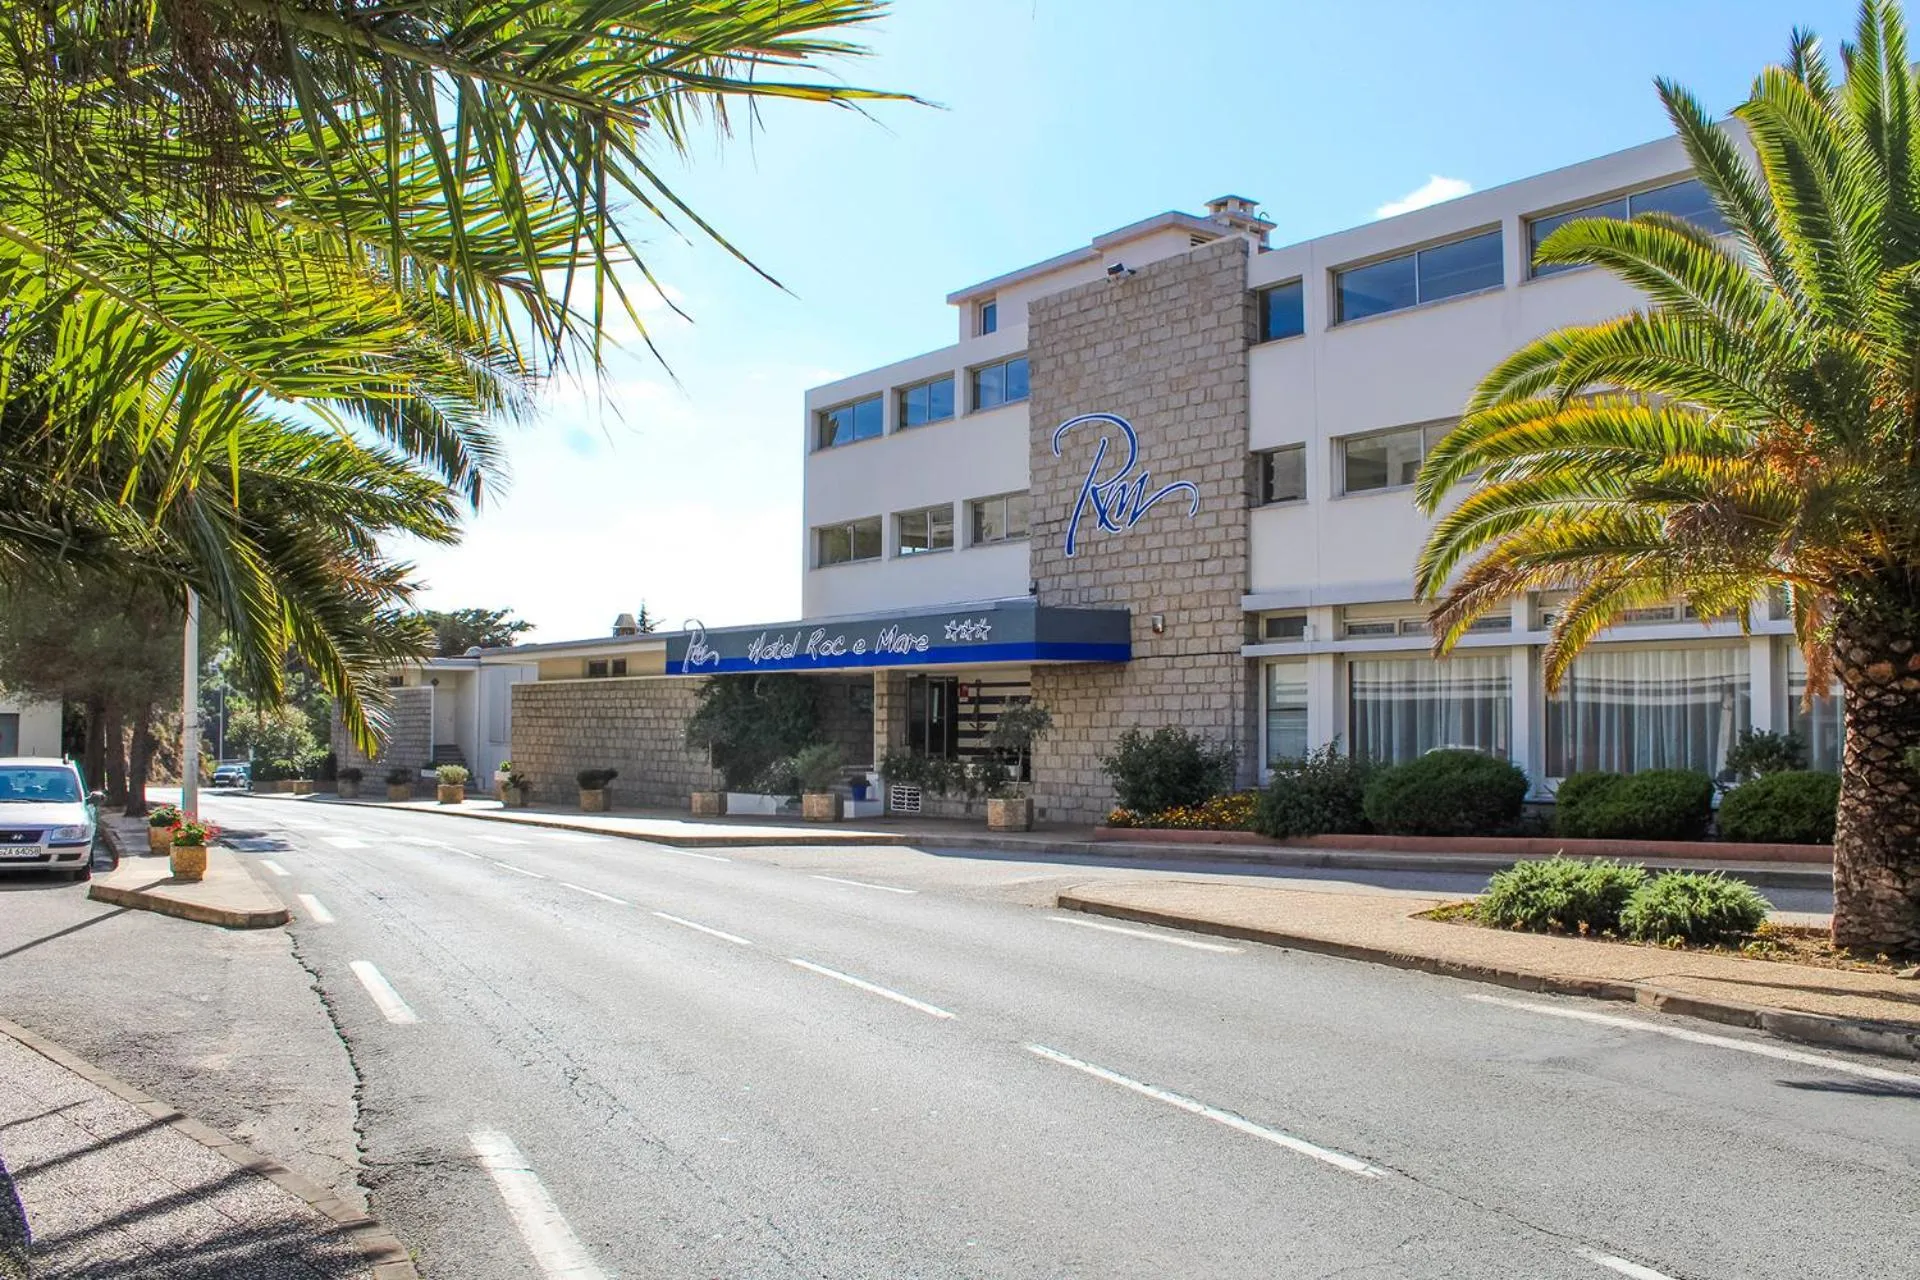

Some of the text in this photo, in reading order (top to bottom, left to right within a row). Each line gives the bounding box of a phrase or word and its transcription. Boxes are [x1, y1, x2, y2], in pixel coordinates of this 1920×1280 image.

[748, 624, 929, 664] Hotel Roc e Mare
